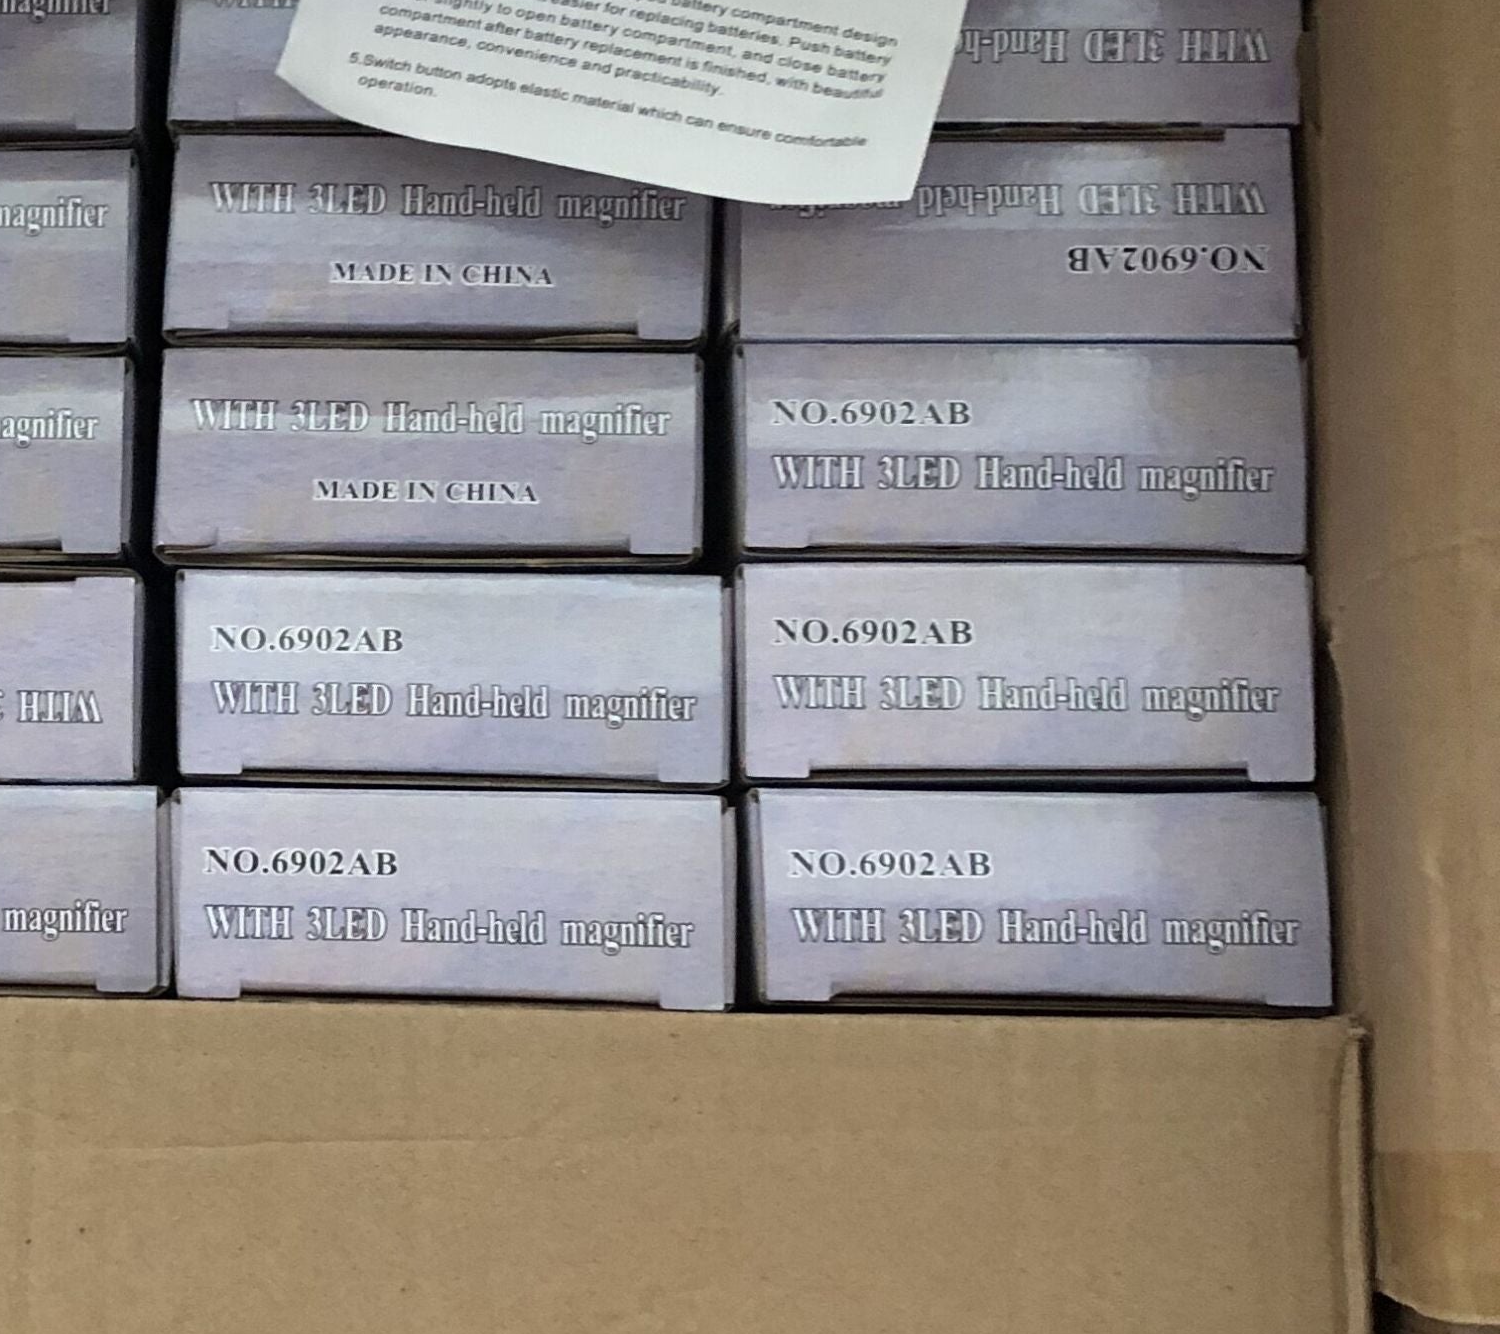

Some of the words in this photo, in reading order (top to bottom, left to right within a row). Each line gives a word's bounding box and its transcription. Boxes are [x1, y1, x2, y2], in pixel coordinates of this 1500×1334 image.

[496, 2, 513, 16] to
[515, 7, 556, 26] open
[559, 13, 619, 37] battery
[621, 26, 737, 58] compartment,
[741, 48, 773, 65] and
[777, 55, 822, 73] close
[826, 63, 888, 86] battery
[603, 2, 625, 17] for
[628, 7, 705, 34] replacing
[706, 21, 783, 46] batteries.
[788, 36, 830, 55] Push
[833, 44, 892, 67] battery
[730, 5, 839, 36] compartment
[840, 26, 898, 50] design
[373, 21, 470, 51] appearance,
[475, 38, 578, 68] convenience
[581, 57, 612, 75] and
[613, 64, 724, 98] practicability.
[379, 1, 481, 33] compartment
[484, 19, 520, 38] after
[523, 26, 580, 51] battery
[582, 37, 682, 69] replacement
[685, 57, 699, 70] is
[701, 60, 772, 86] finished,
[774, 74, 808, 91] with
[811, 78, 884, 105] beautiful
[953, 28, 1069, 63] Hand-h
[1083, 29, 1163, 63] 3LED
[1179, 29, 1270, 63] WITH
[348, 50, 411, 74] 5.Switch
[415, 62, 462, 81] button
[465, 71, 517, 92] adopts
[519, 81, 570, 102] elastic
[572, 92, 635, 114] material
[637, 104, 682, 123] which
[685, 114, 713, 129] can
[716, 121, 772, 141] ensure
[774, 124, 868, 157] comfortable
[356, 73, 437, 100] operation.
[209, 182, 296, 215] WITH
[308, 184, 387, 216] 3LED
[400, 185, 542, 218] Hand-held
[557, 188, 687, 228] magnifier
[917, 185, 1060, 217] Hand-held
[1078, 184, 1159, 215] 3LED
[1174, 183, 1267, 215] WITH
[333, 263, 413, 283] MADE
[424, 264, 452, 284] IN
[462, 265, 553, 287] CHINA
[1069, 245, 1268, 273] NO.6902AB
[191, 400, 278, 432] WITH
[291, 401, 369, 433] 3LED
[383, 402, 525, 435] Hand-held
[539, 405, 671, 443] magnifier
[772, 401, 971, 424] NO.6902AB
[314, 480, 398, 500] MADE
[406, 481, 434, 501] IN
[446, 482, 538, 503] CHINA
[772, 455, 863, 489] WITH
[877, 456, 960, 490] 3LED
[975, 456, 1124, 491] Hand-held
[1139, 458, 1274, 499] magnifier
[211, 627, 403, 652] NO.6902AB
[774, 620, 973, 645] NO.6902AB
[17, 690, 102, 723] WITH
[211, 681, 298, 715] WITH
[312, 683, 393, 717] 3LED
[407, 684, 549, 719] Hand-held
[565, 688, 697, 728] magnifier
[774, 675, 866, 710] WITH
[880, 676, 962, 711] 3LED
[978, 677, 1127, 713] Hand-held
[1142, 679, 1280, 720] magnifier
[206, 848, 399, 876] NO.6902AB
[791, 851, 991, 877] NO.6902AB
[3, 901, 128, 941] magnifier
[204, 906, 294, 940] WITH
[307, 907, 387, 941] 3LED
[401, 908, 545, 945] Hand-held
[561, 914, 694, 954] magnifier
[792, 908, 884, 943] WITH
[899, 909, 982, 944] 3LED
[999, 909, 1147, 945] Hand-held
[1163, 912, 1299, 953] magnifier
